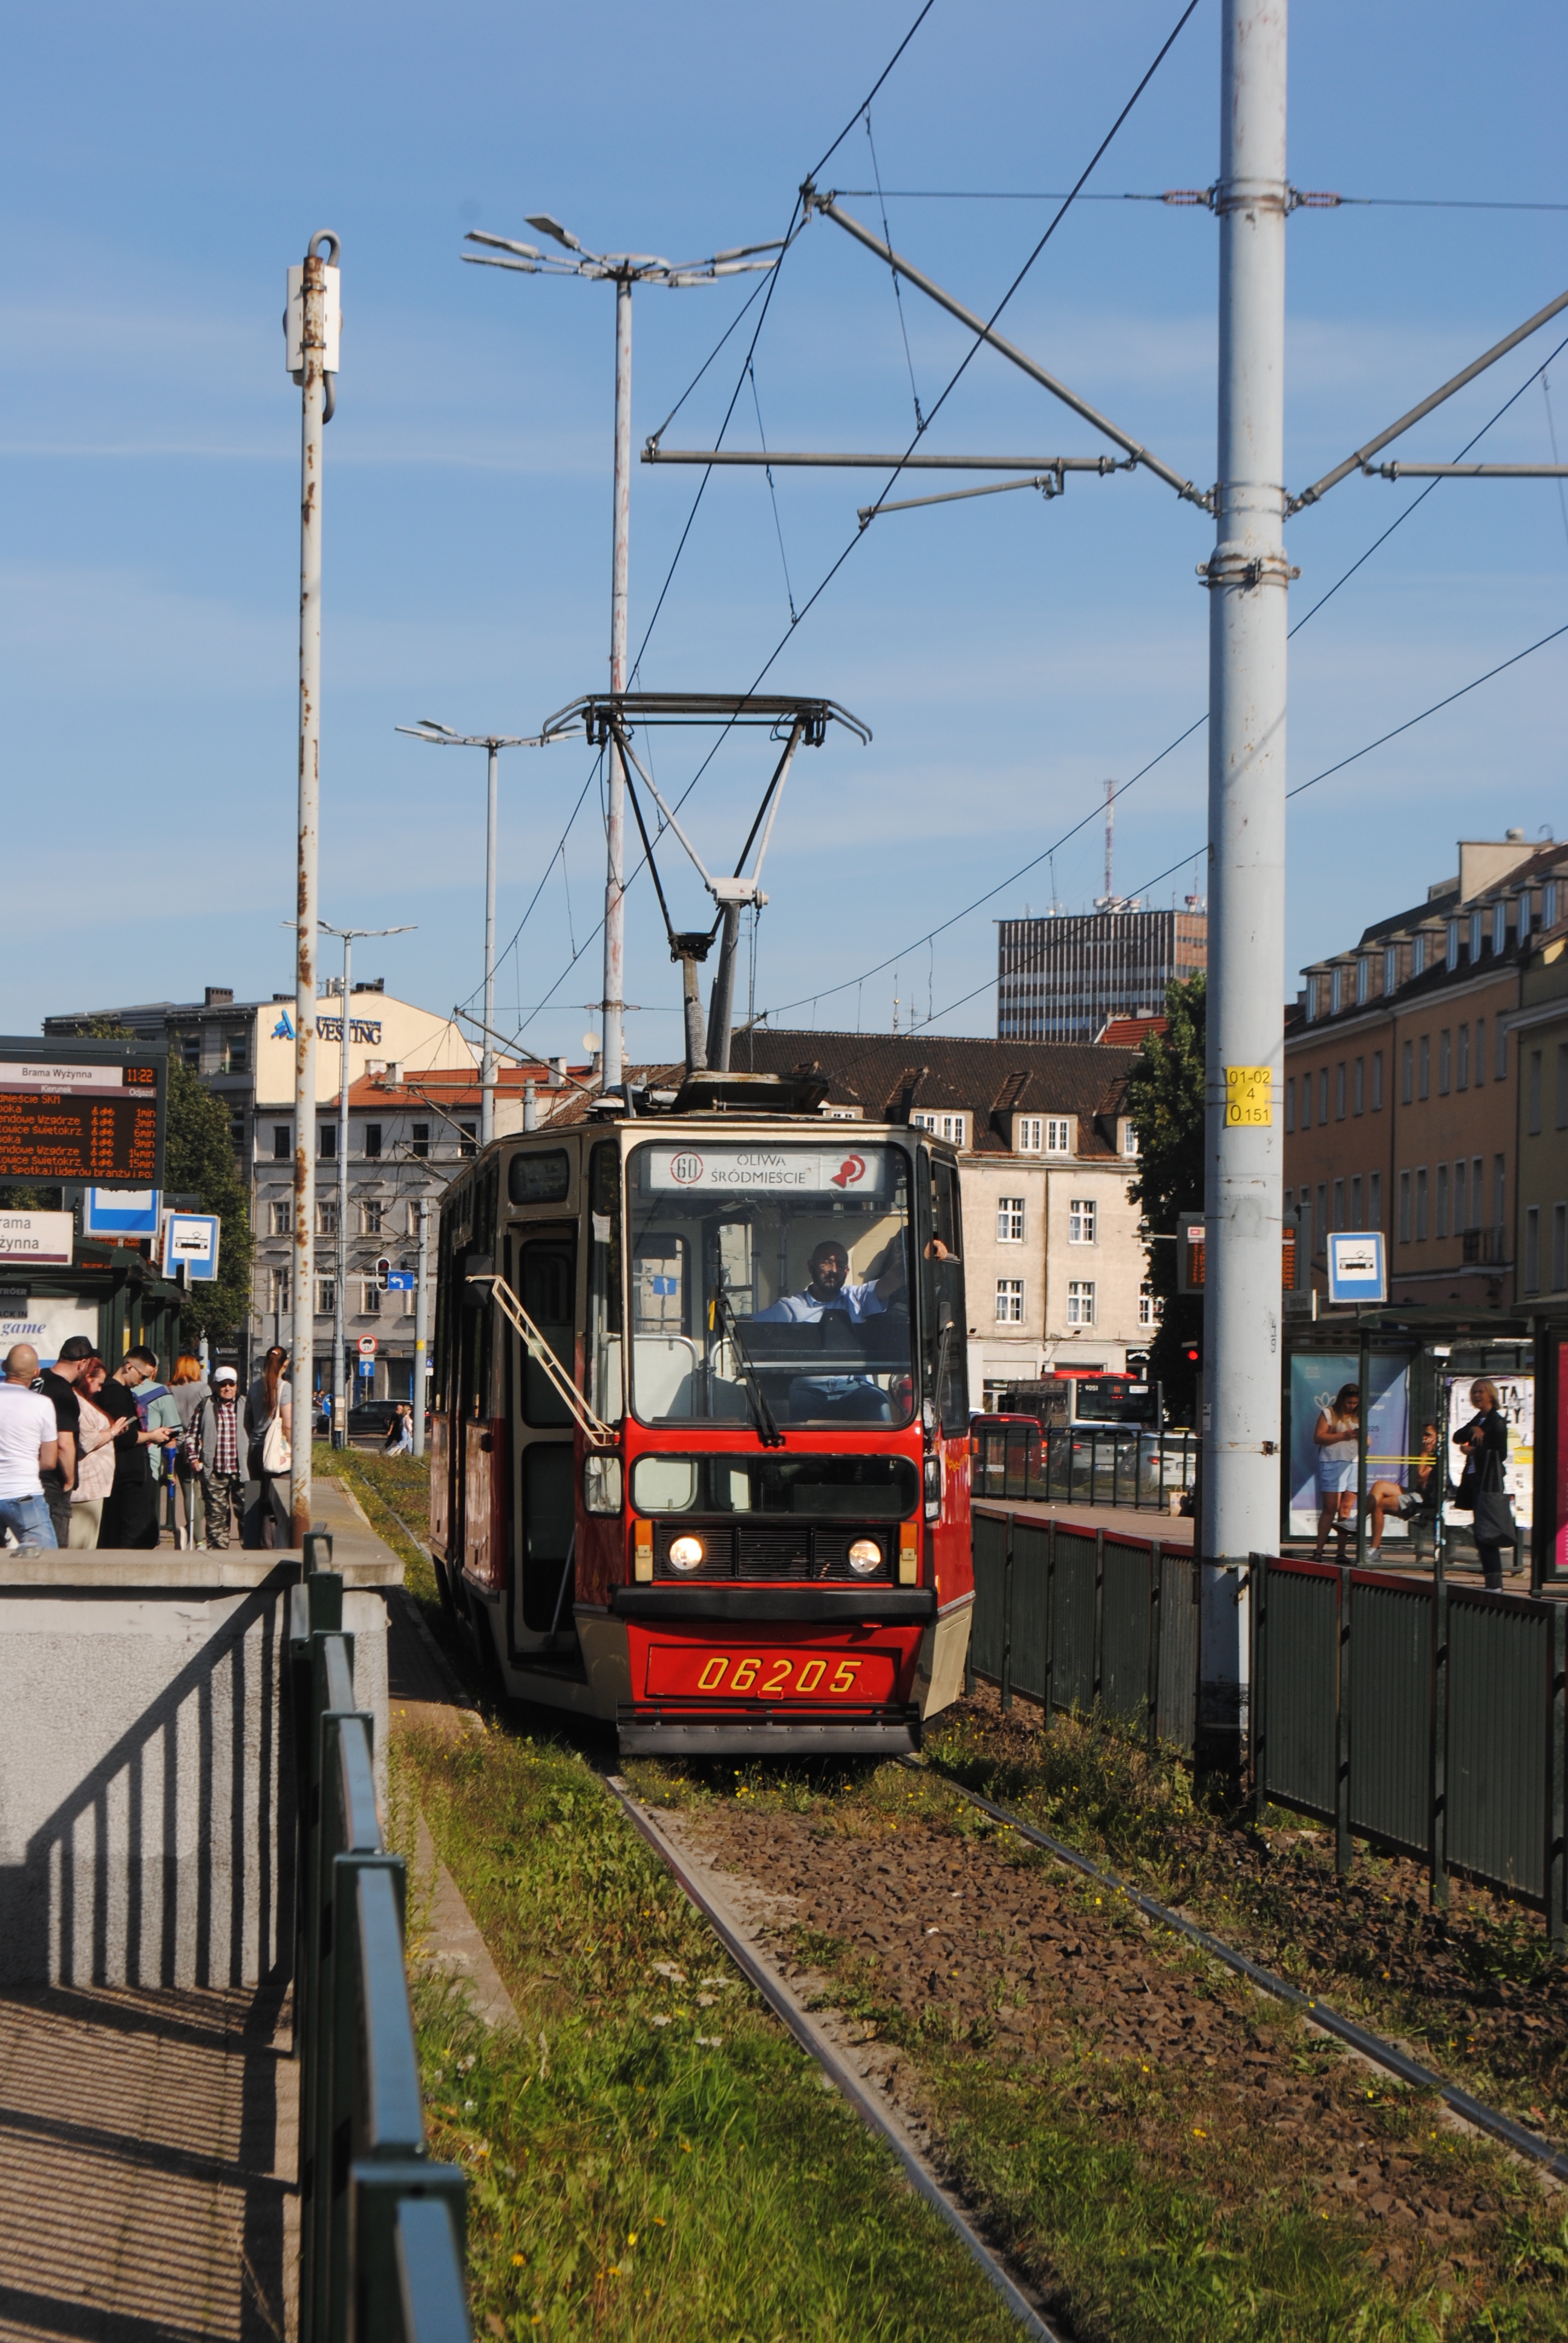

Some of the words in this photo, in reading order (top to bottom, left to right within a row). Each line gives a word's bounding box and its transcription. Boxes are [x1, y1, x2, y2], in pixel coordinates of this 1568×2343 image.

[22, 1067, 50, 1077] Brama
[53, 1069, 92, 1080] Wyżynna
[128, 1068, 153, 1082] 11:22
[1229, 1071, 1270, 1084] 01-02
[41, 1084, 72, 1093] Kierunek
[129, 1089, 154, 1098] Odjazd
[1247, 1087, 1255, 1099] 4
[41, 1095, 60, 1104] SKM
[136, 1109, 155, 1118] 1min
[1230, 1105, 1268, 1121] 0.151
[38, 1115, 80, 1126] Wzgórze
[134, 1118, 155, 1127] 3min
[32, 1126, 84, 1136] Świętokrz.
[134, 1129, 155, 1138] 6min
[134, 1139, 155, 1148] 9min
[37, 1145, 80, 1156] Wzgórze
[128, 1149, 155, 1158] 14min
[128, 1159, 155, 1168] 15min
[737, 1154, 786, 1167] OLIWA
[12, 1165, 52, 1175] Spotkaj
[55, 1166, 91, 1176] liderów
[94, 1168, 131, 1179] branży
[677, 1158, 697, 1178] 60
[711, 1168, 806, 1184] ŚRÓDMIEŚCIE
[0, 1322, 47, 1337] game
[697, 1657, 863, 1693] 06205
